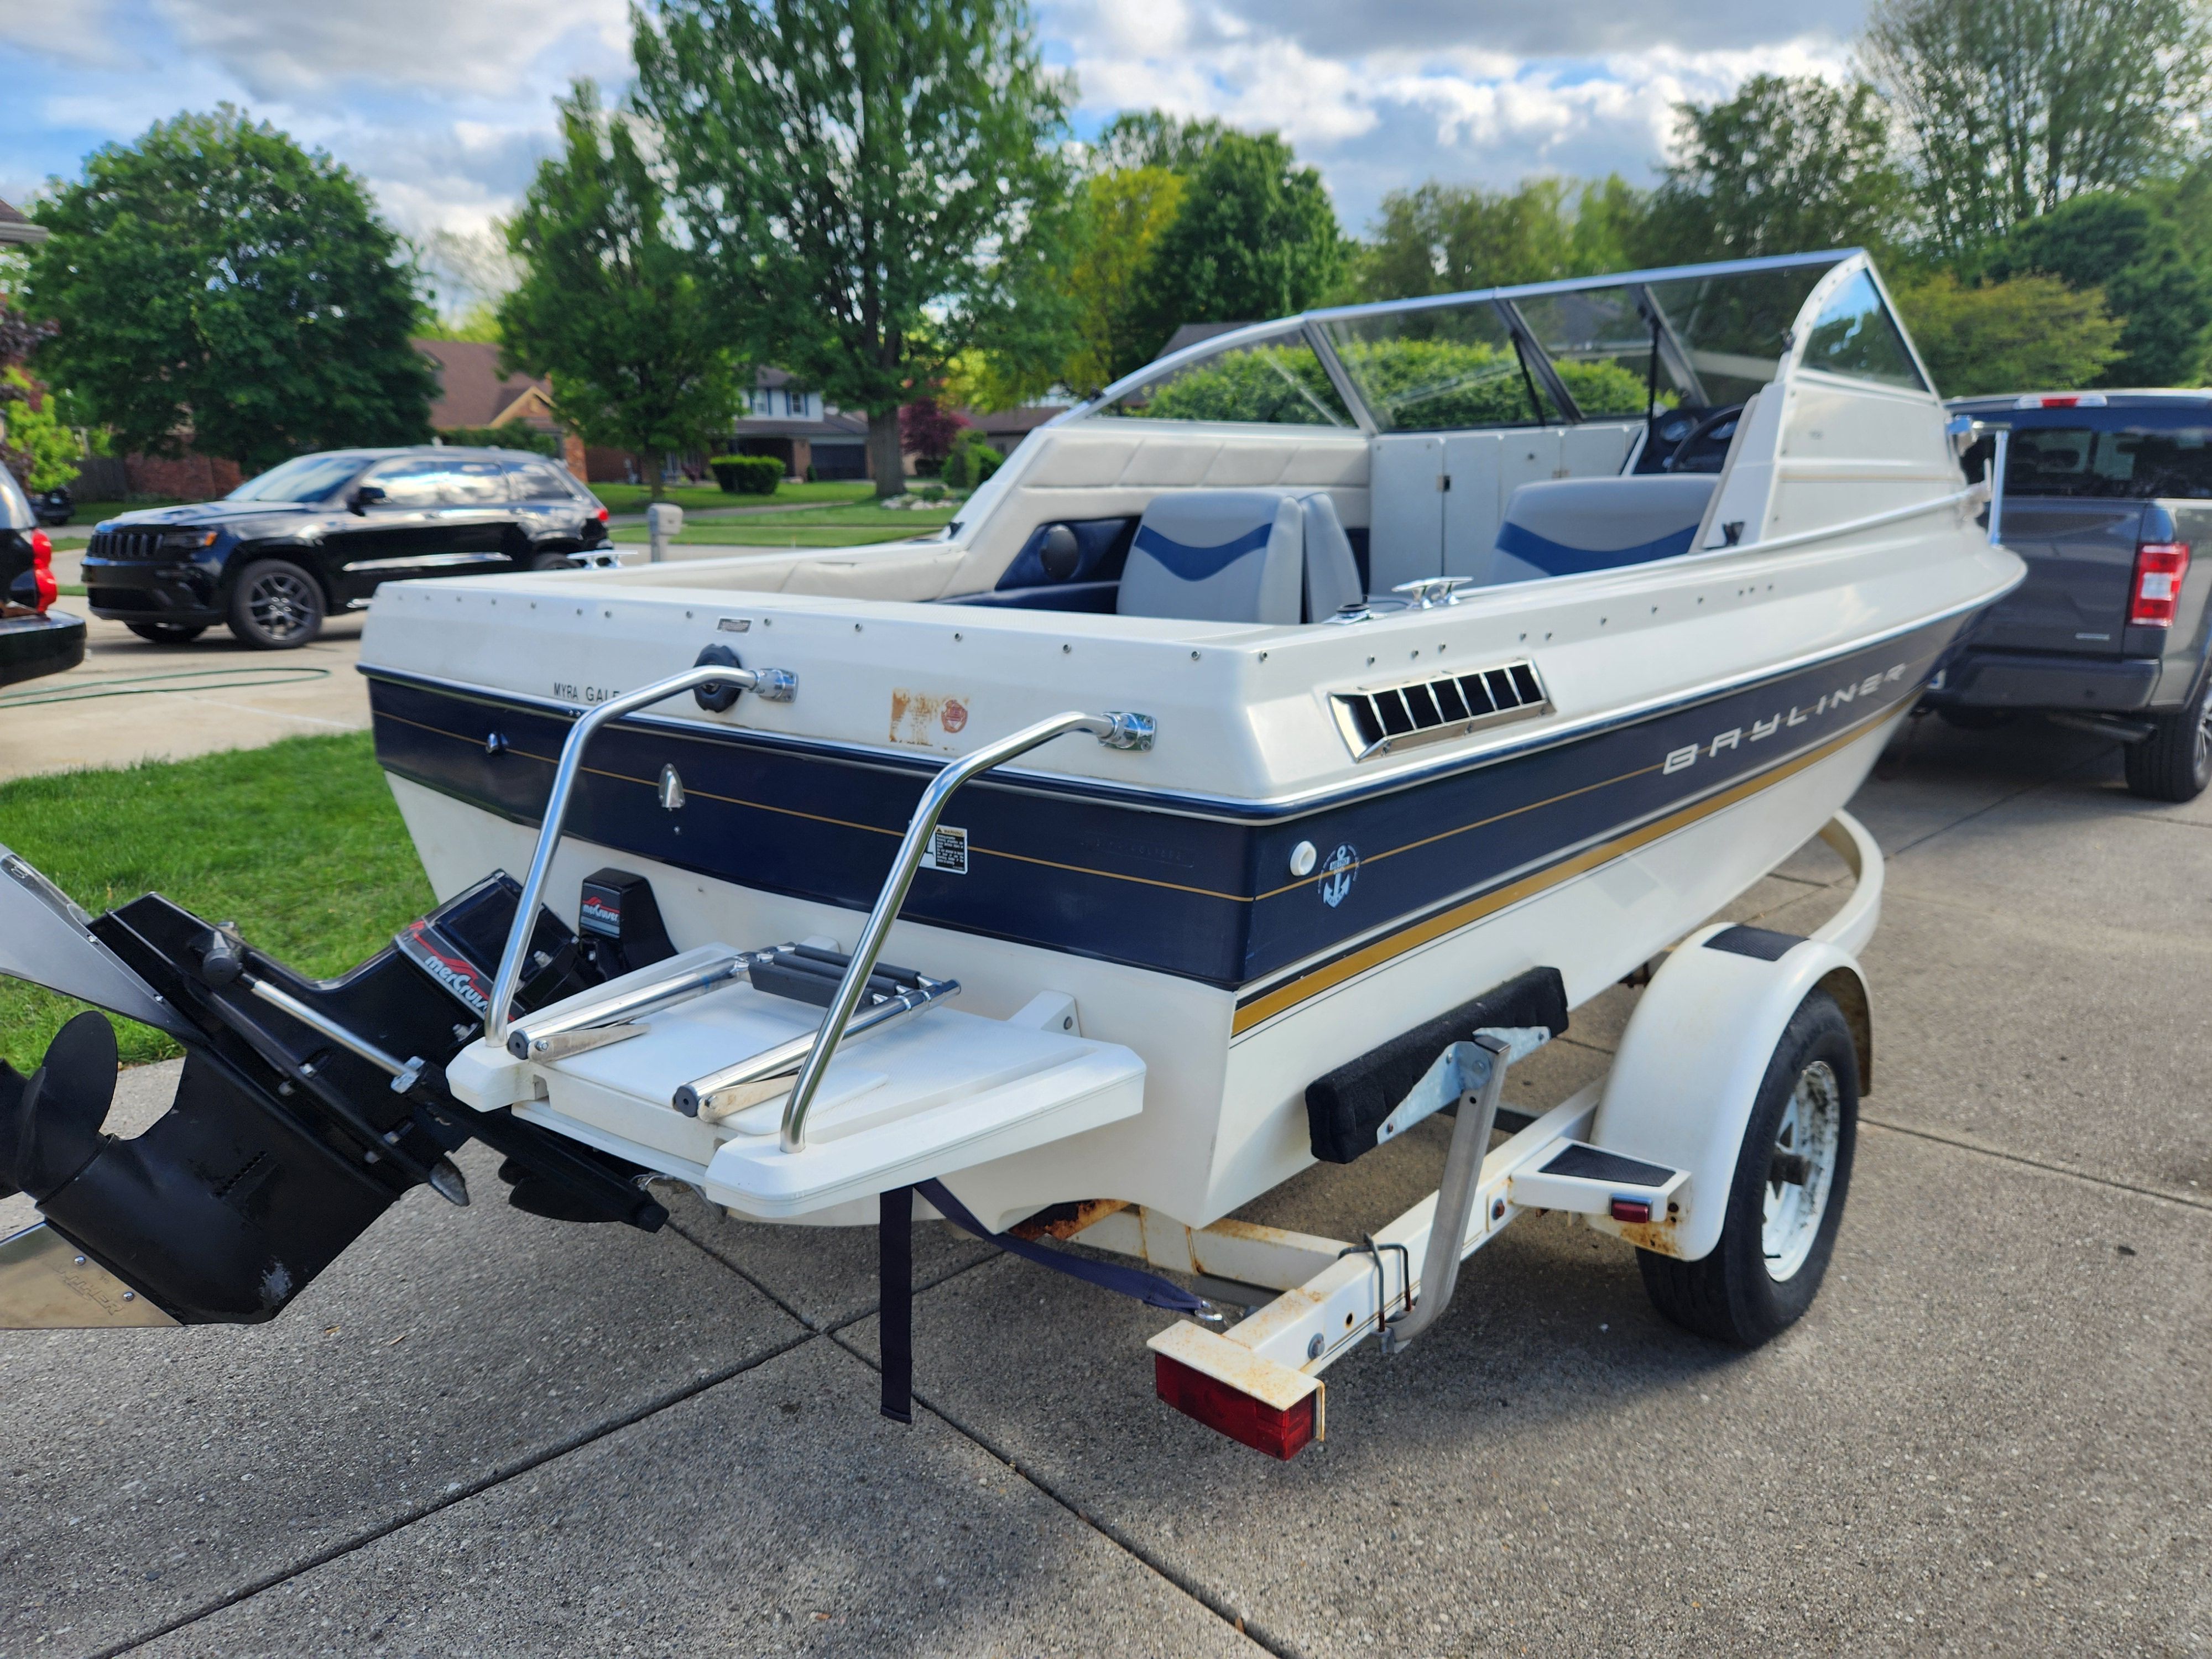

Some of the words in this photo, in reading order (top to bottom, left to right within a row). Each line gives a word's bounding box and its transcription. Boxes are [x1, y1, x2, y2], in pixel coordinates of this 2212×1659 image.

[554, 682, 578, 700] MYRA
[1663, 663, 1906, 774] BAYLINER
[425, 955, 489, 1013] merCruis
